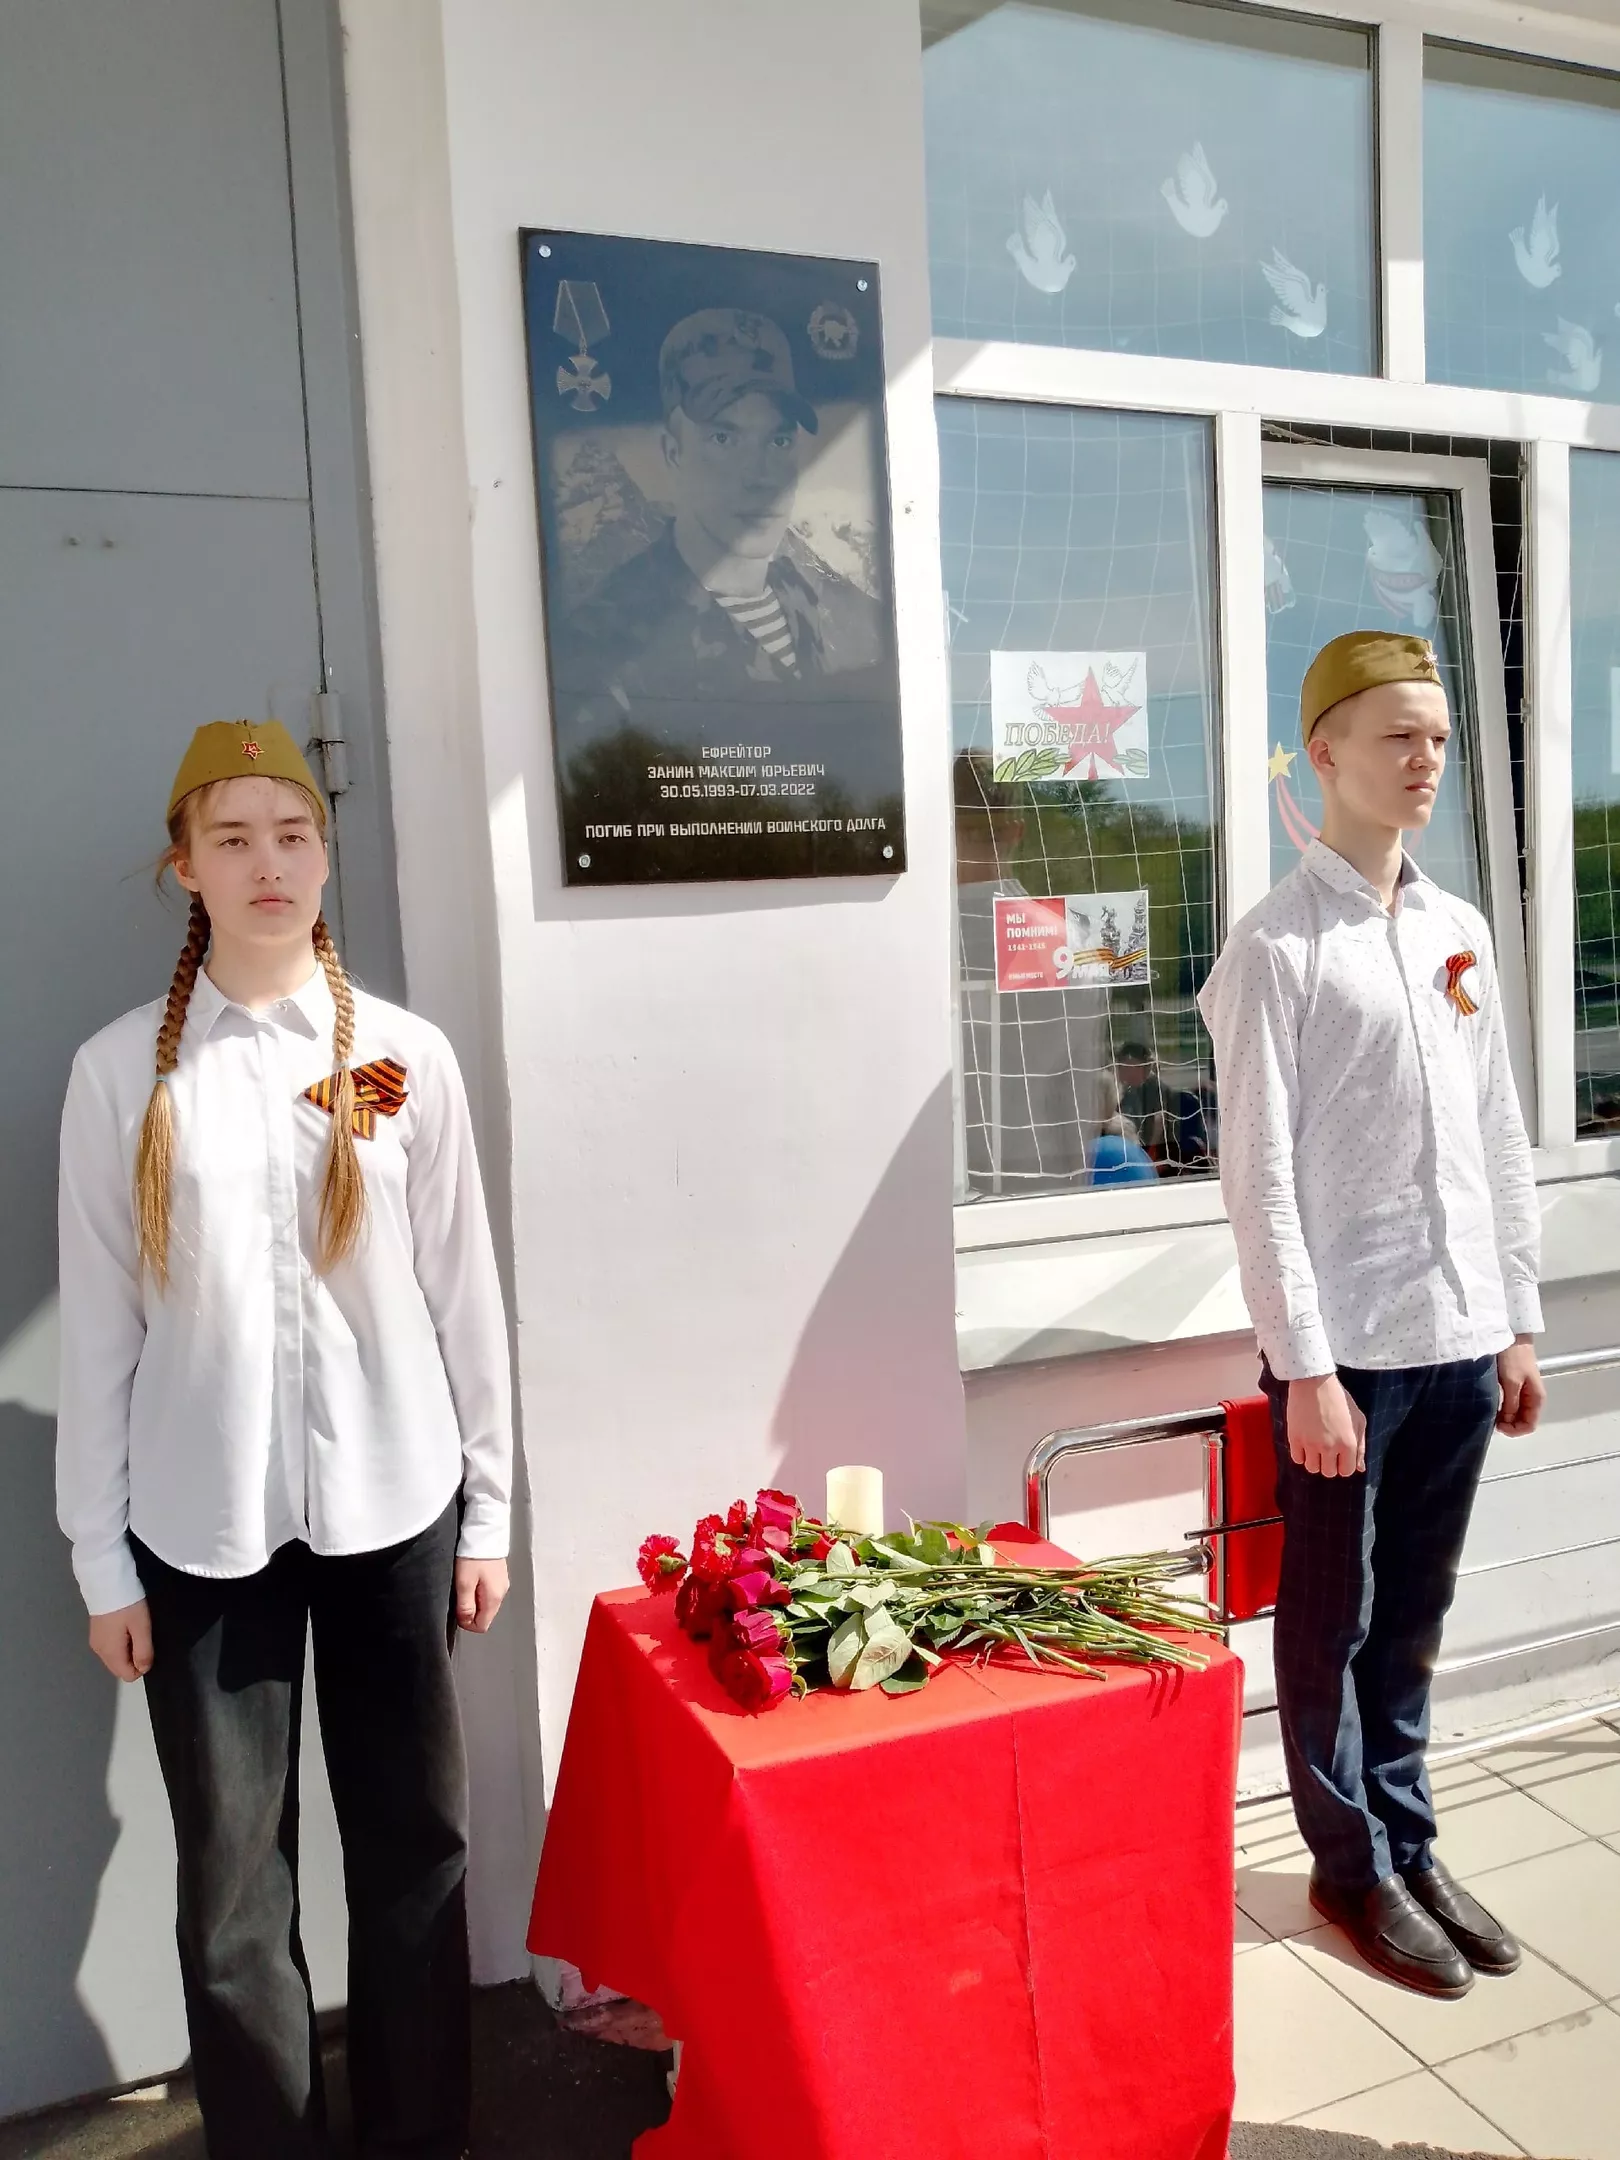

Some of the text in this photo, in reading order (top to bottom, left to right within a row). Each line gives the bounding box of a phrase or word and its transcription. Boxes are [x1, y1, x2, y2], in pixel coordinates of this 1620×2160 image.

[1004, 722, 1110, 748] ПОБЕДА!
[702, 743, 772, 759] ЕФРЕЙТОР
[648, 764, 825, 780] ЗАНИН МАКСИМ ЮРЬЕВИЧ
[660, 783, 816, 799] 30.05.1993-07.03.2022
[585, 818, 886, 839] ПОГИБ ПРИ ВЫПОЛНЕНИИ ВОИНСКОГО ДОЛГА
[1006, 913, 1026, 925] МЫ
[1006, 926, 1058, 939] ПОМНИМ!
[1053, 946, 1074, 980] 9
